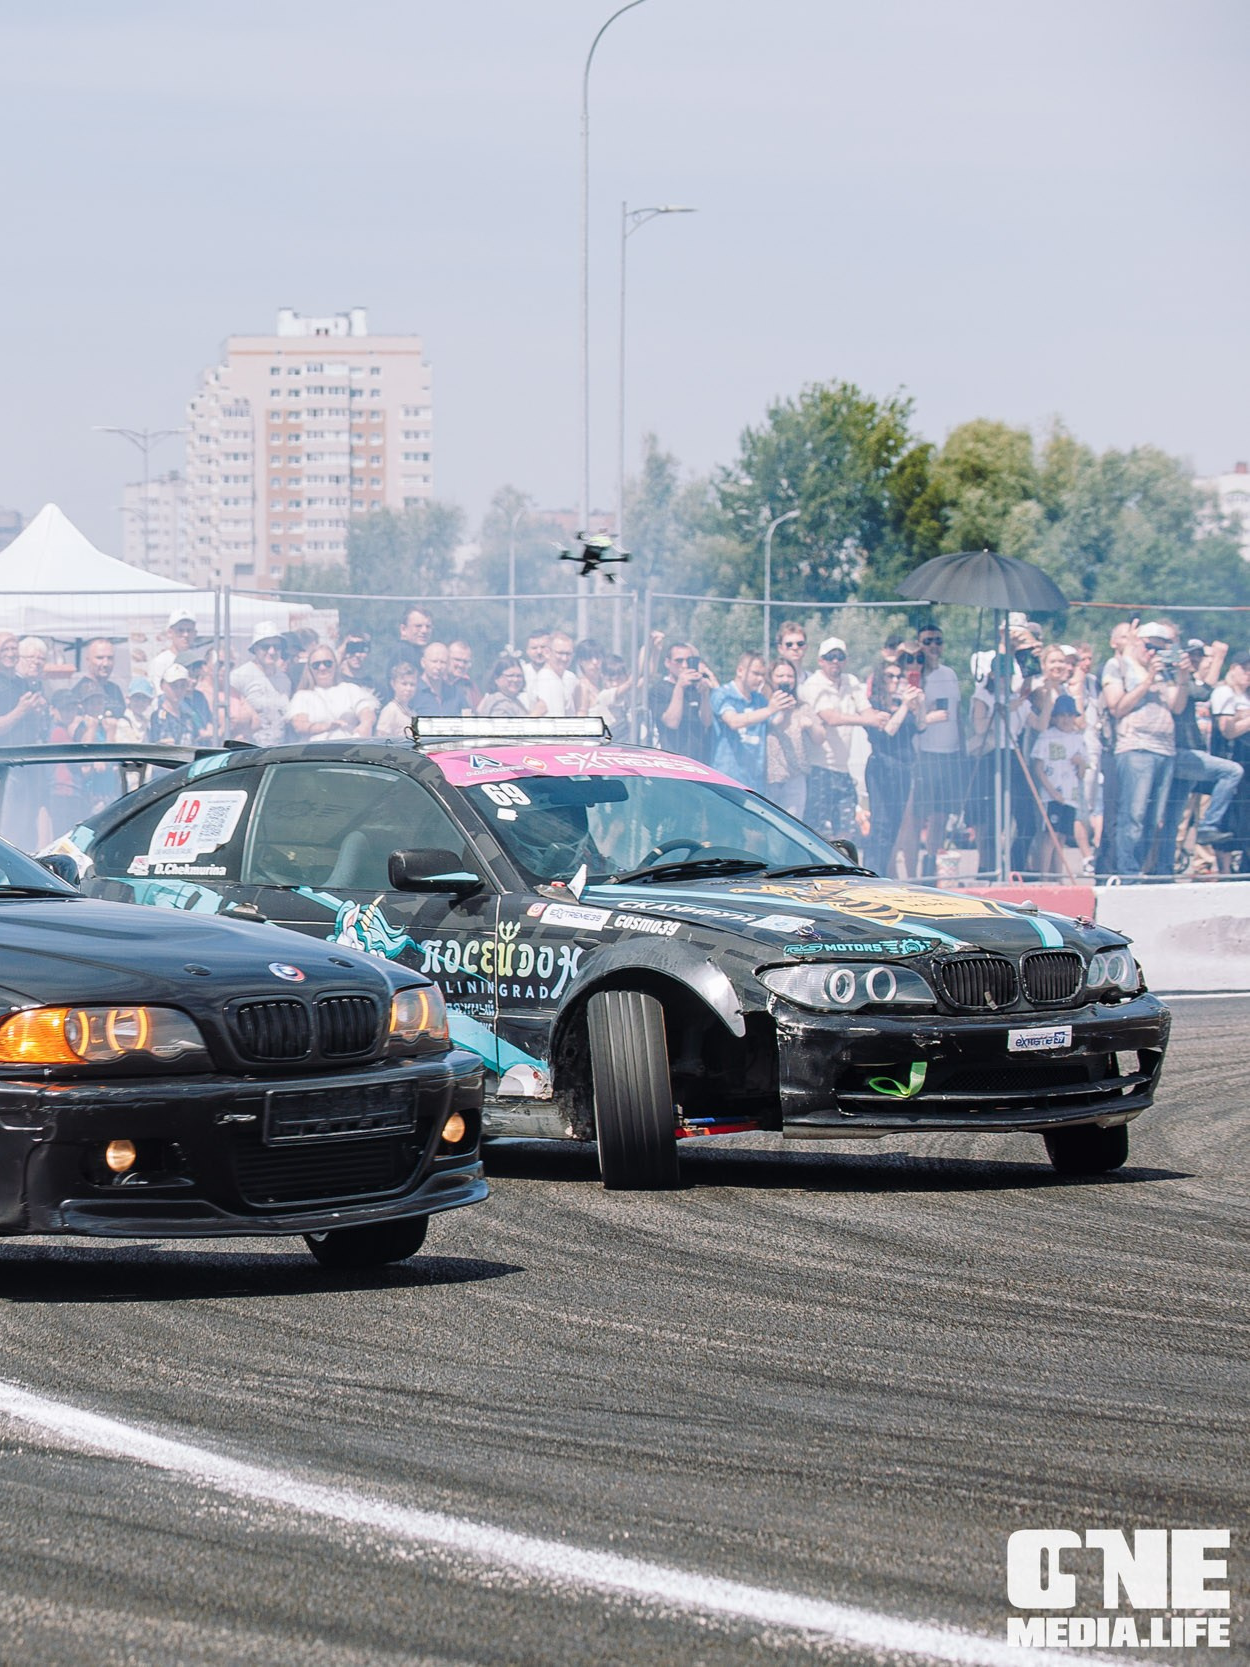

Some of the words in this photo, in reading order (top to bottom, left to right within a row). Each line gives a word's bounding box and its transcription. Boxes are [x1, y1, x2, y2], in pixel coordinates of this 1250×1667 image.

[481, 783, 531, 807] 69
[154, 863, 227, 876] D.Chekmurina
[550, 908, 602, 921] EXTREME39
[617, 901, 756, 923] СКАНИРУЙ
[824, 943, 883, 952] MOTORS
[433, 979, 549, 999] ALININGRAD
